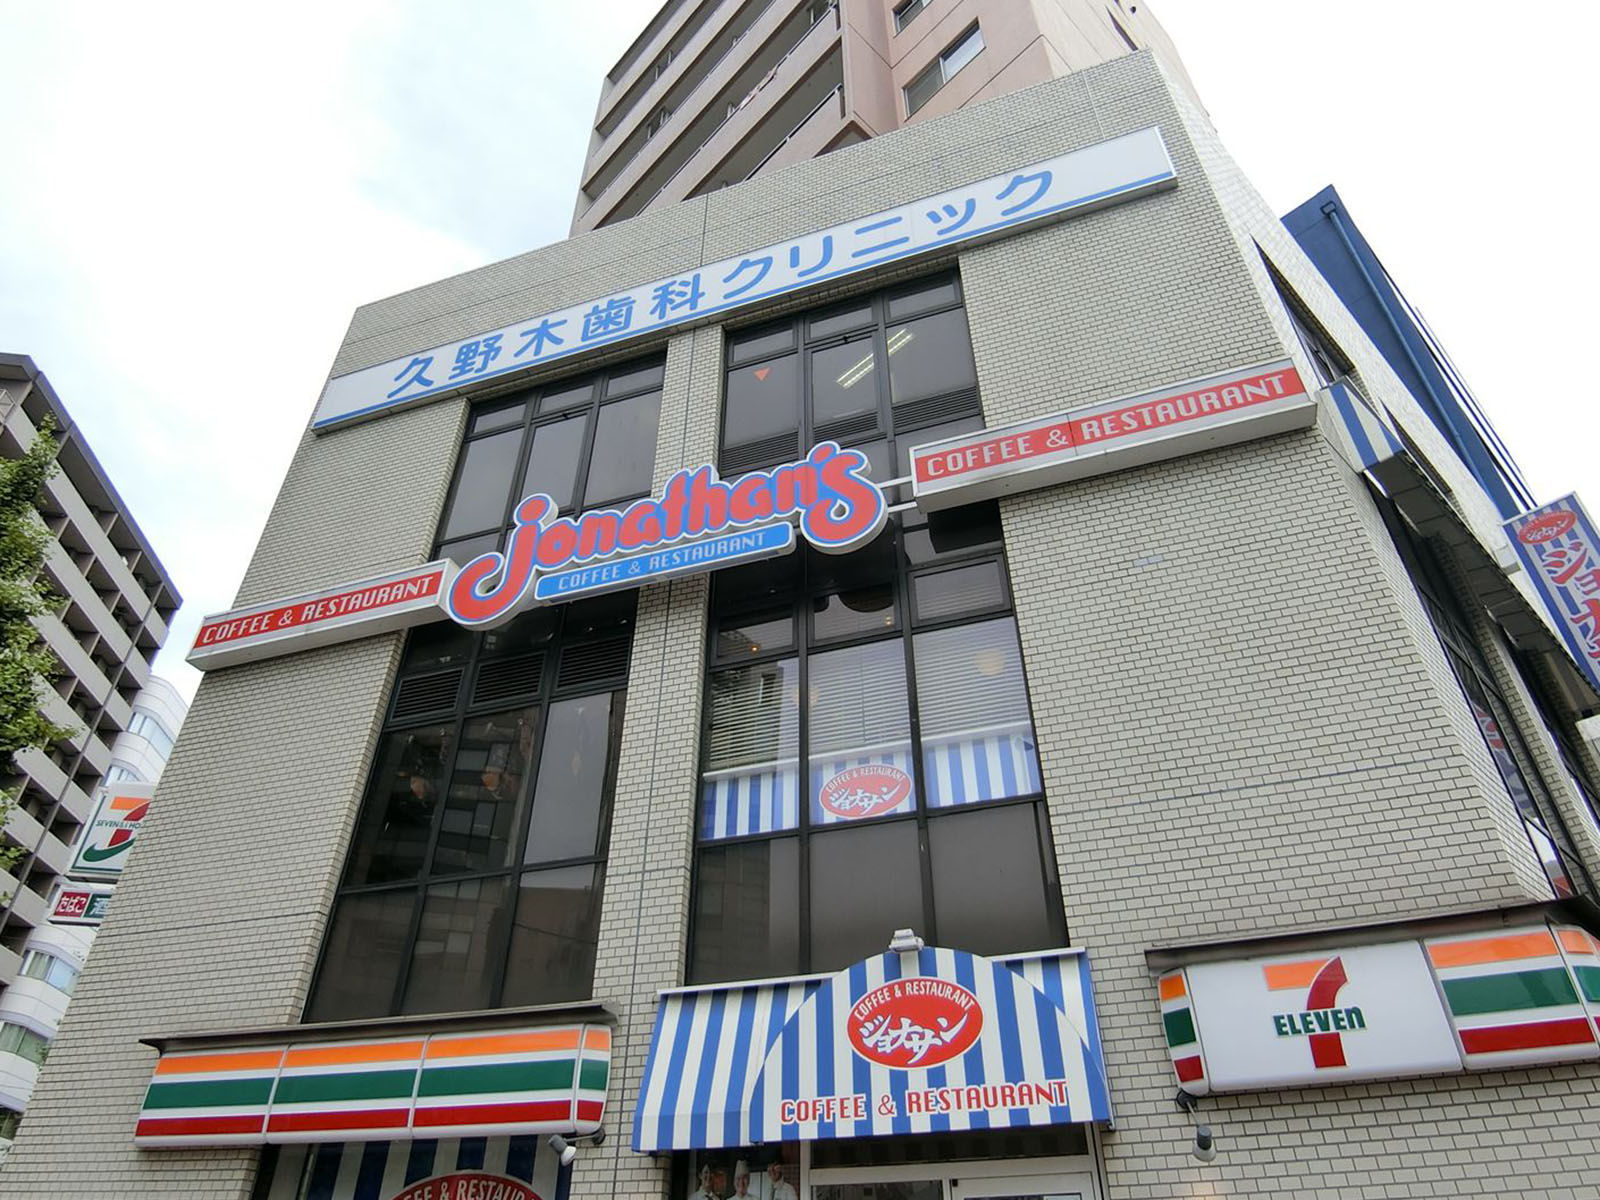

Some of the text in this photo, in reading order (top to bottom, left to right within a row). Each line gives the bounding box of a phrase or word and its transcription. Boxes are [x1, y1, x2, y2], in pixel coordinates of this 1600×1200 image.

[387, 171, 1054, 399] 久野木歯科クリニック
[926, 375, 1284, 478] COFFEE & RESTAURANT
[558, 532, 767, 591] COFFEE & RESTAURANT
[202, 575, 434, 644] COFFEE & RESTAURANT
[825, 773, 851, 793] COFFEE
[860, 766, 906, 781] RESTAURANT
[56, 895, 88, 914] たばこ
[854, 981, 975, 1021] COFFEE & RESTAURANT
[857, 1012, 969, 1065] ジョナサン
[781, 1079, 1067, 1124] COFFEE & RESTAURANT
